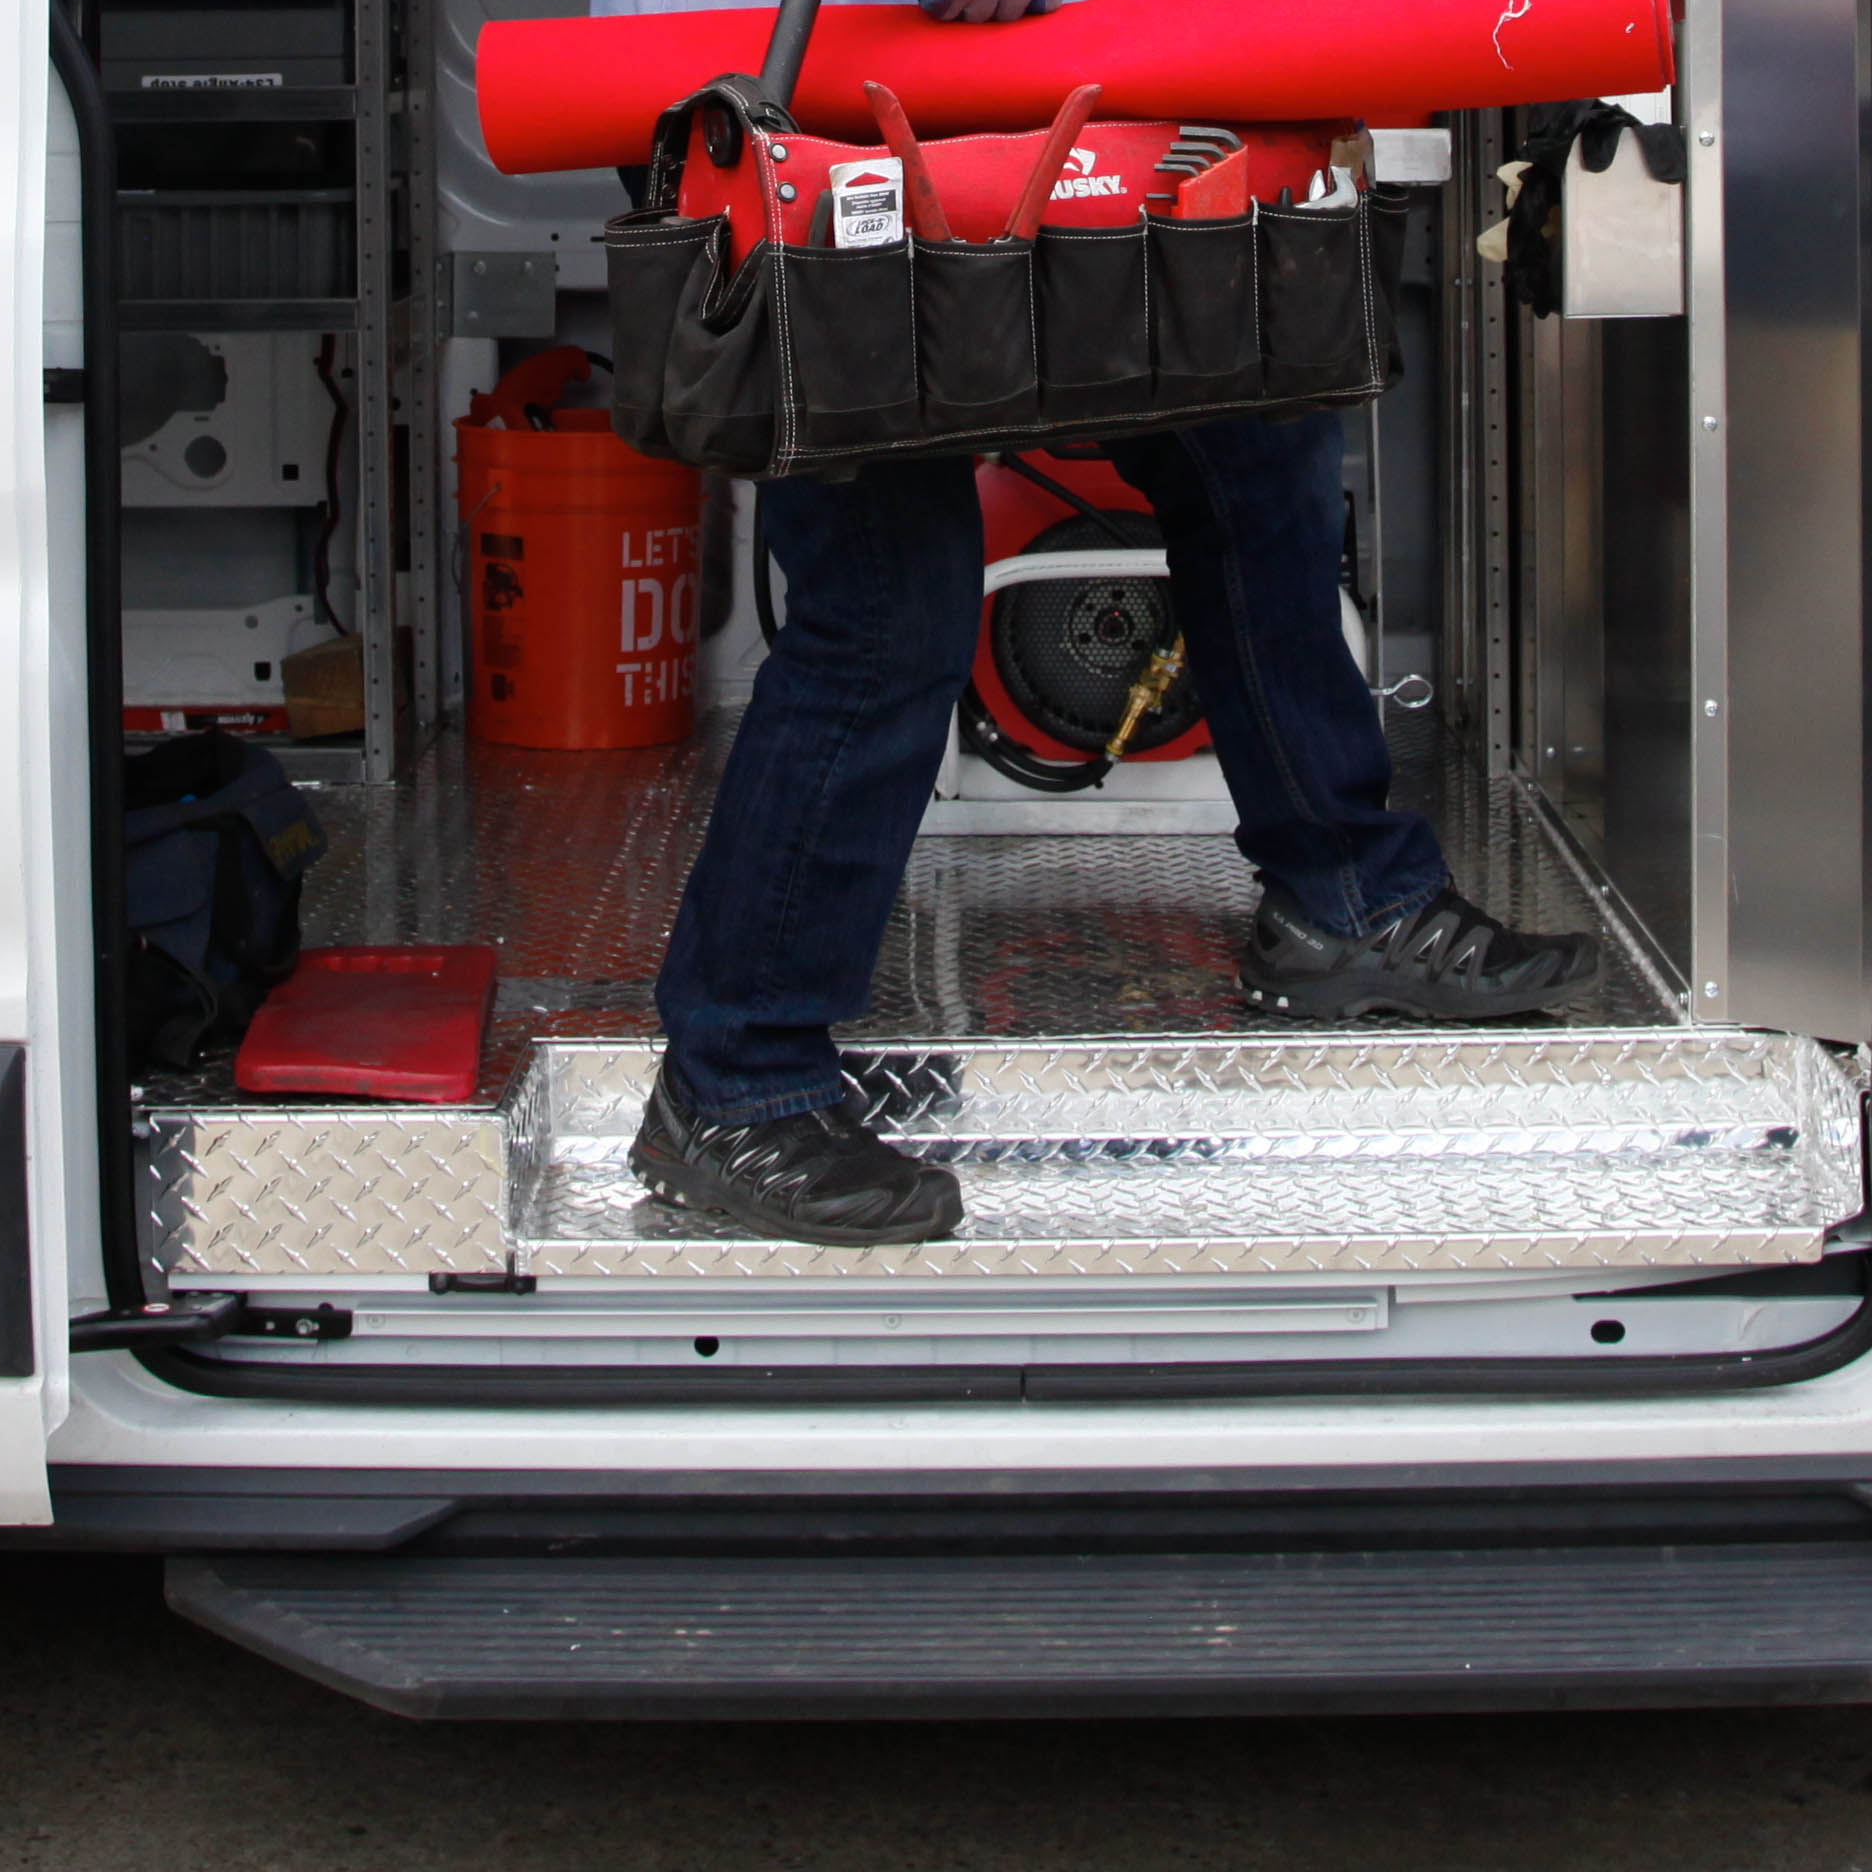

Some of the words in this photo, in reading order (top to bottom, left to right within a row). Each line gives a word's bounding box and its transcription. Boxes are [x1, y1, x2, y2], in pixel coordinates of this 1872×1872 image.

[1049, 174, 1122, 201] USKY
[620, 573, 700, 652] DO
[616, 654, 696, 707] THIS
